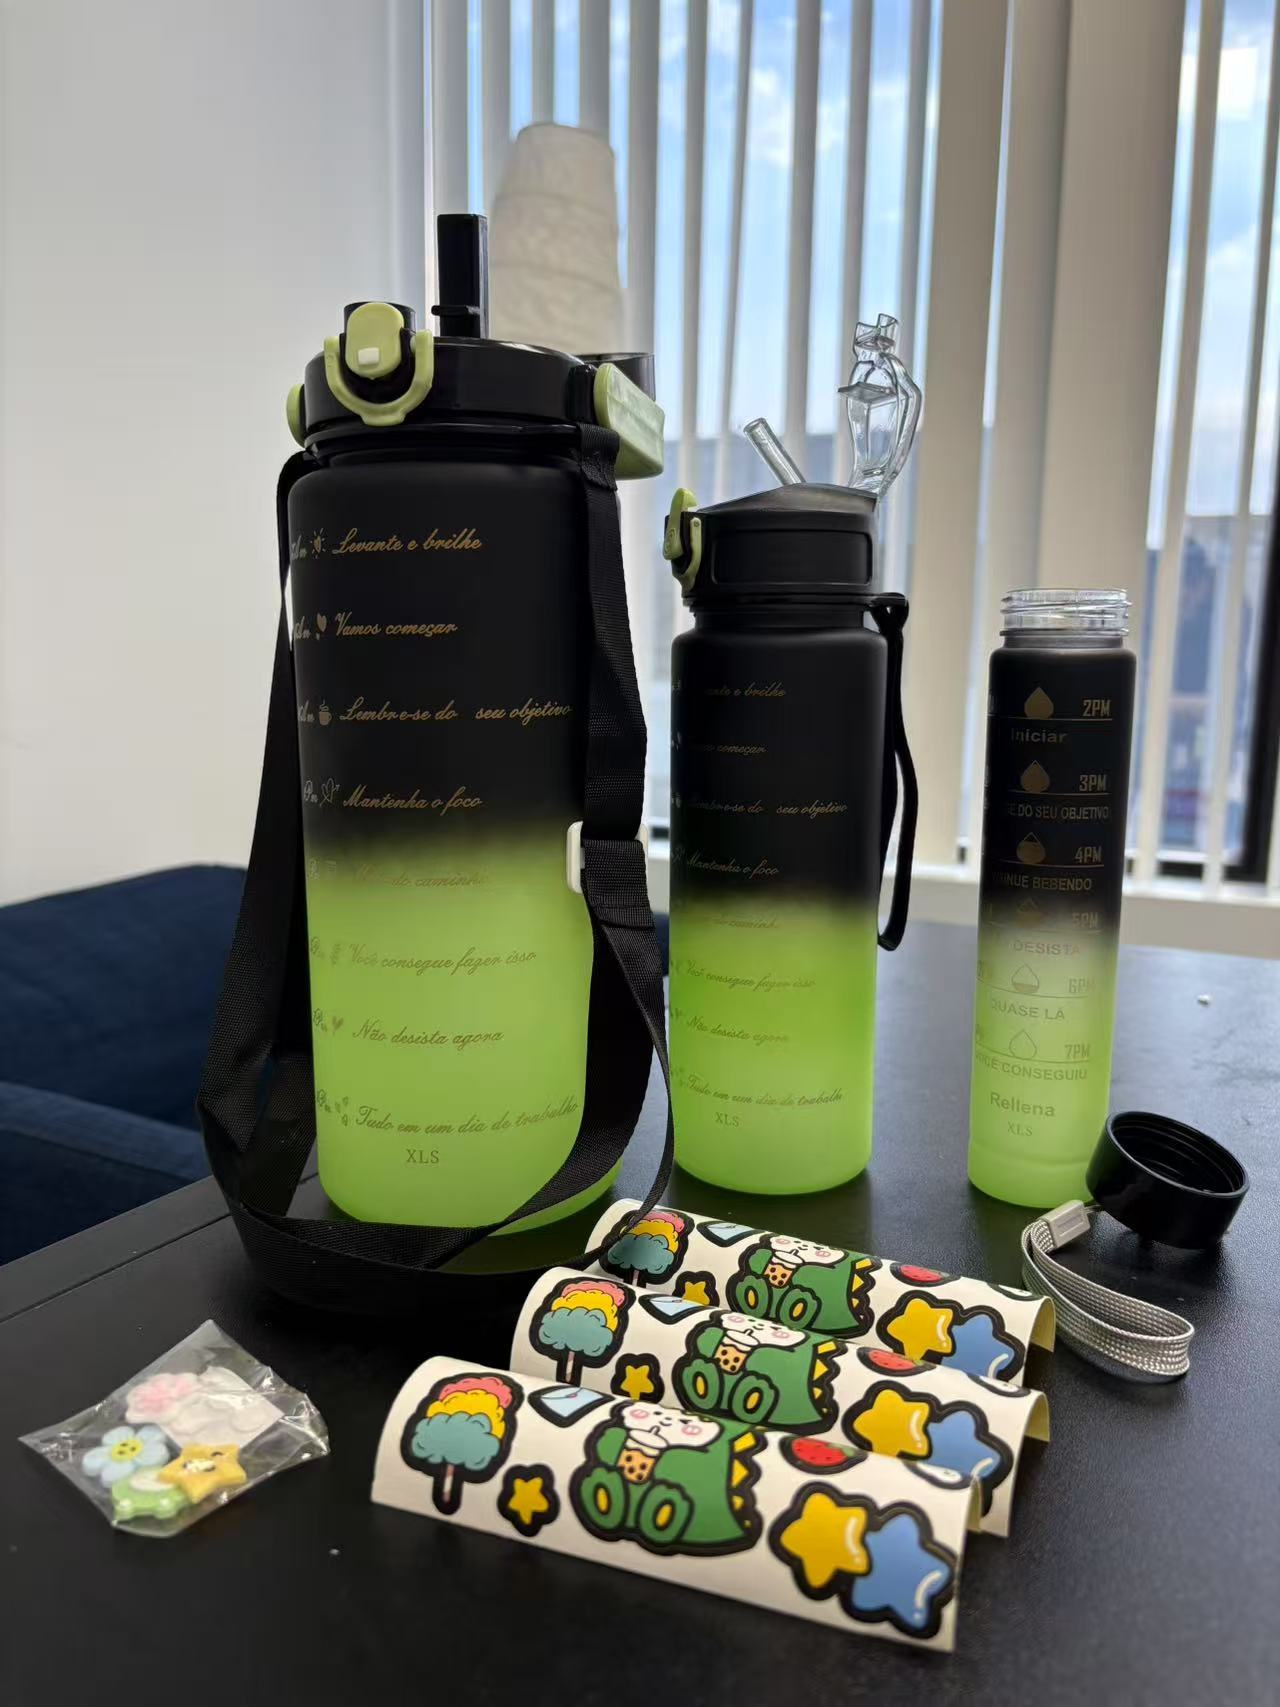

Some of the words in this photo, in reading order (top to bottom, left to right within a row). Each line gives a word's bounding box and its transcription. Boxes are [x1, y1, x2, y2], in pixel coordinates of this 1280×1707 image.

[332, 528, 403, 554] Levante
[407, 540, 417, 550] e
[423, 528, 482, 550] brilhe
[335, 611, 381, 636] Vamos
[385, 623, 459, 637] começar
[435, 700, 459, 721] do
[475, 707, 505, 720] seu
[509, 698, 572, 726] objetivo
[1083, 699, 1111, 717] 2PM
[1010, 727, 1068, 743] Iniciar
[1079, 774, 1107, 791] 3PM
[343, 784, 427, 808] Mantenha
[431, 798, 443, 808] o
[440, 786, 482, 816] foco
[1035, 806, 1057, 819] SEU
[1060, 807, 1109, 820] OBJETIVO
[1075, 847, 1102, 864] 4PM
[1033, 876, 1093, 891] BEBENDO
[381, 959, 455, 976] consegue
[353, 1018, 388, 1041] Não
[391, 1027, 449, 1045] desista
[452, 1031, 503, 1051] agora
[1065, 1043, 1090, 1060] 7PM
[1002, 1062, 1087, 1081] CONSEGUIU
[990, 1091, 1056, 1117] Rellena
[355, 1105, 395, 1131] Tudo
[398, 1123, 420, 1135] em
[425, 1123, 453, 1135] um
[458, 1113, 488, 1133] dia
[491, 1110, 512, 1131] de
[714, 1112, 740, 1128] XLS
[1008, 1121, 1034, 1137] XLS
[406, 1149, 440, 1165] XLS
